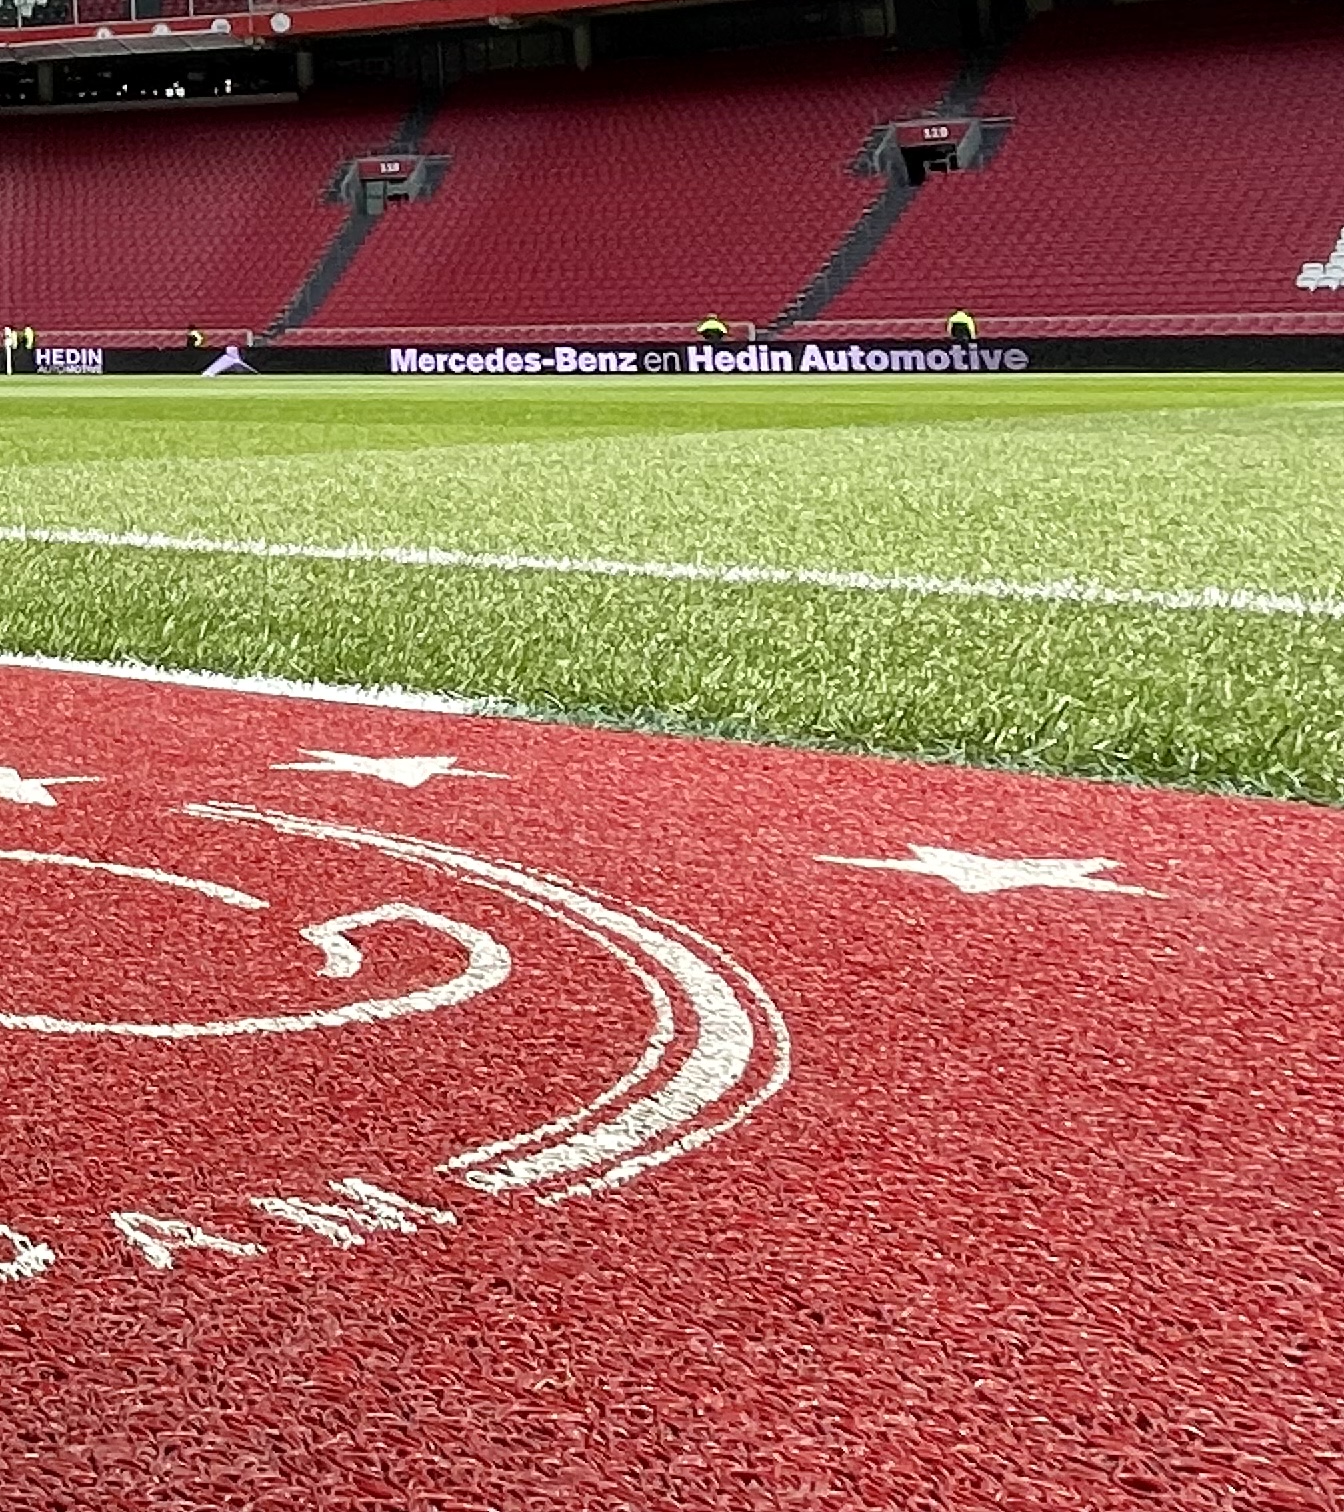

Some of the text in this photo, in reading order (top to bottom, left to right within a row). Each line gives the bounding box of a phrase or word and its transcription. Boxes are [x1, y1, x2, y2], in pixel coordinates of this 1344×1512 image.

[35, 348, 102, 365] HEDIN
[390, 343, 1030, 373] Mercedes-Benz en Hedin Automotive
